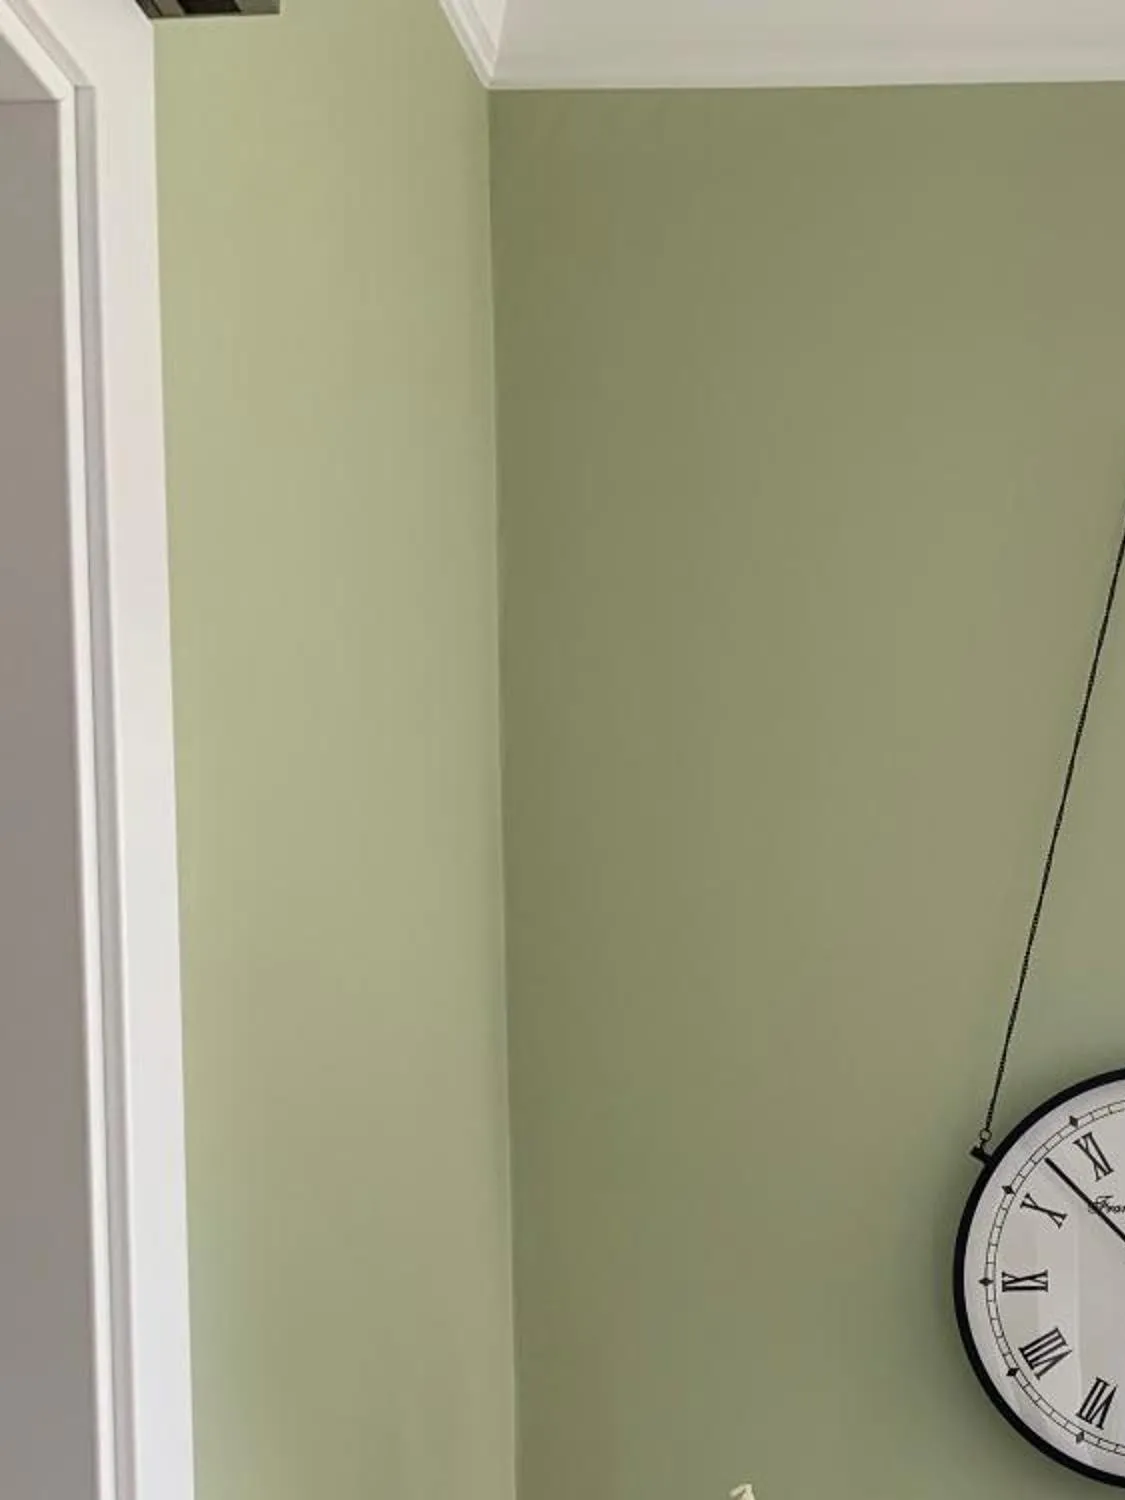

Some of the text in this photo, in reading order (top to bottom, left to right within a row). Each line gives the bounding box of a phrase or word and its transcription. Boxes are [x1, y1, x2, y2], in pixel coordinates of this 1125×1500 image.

[1073, 1132, 1114, 1181] XI
[1020, 1193, 1068, 1228] X
[1001, 1269, 1049, 1292] IX
[1018, 1327, 1073, 1380] VIII
[1077, 1376, 1118, 1430] VII
